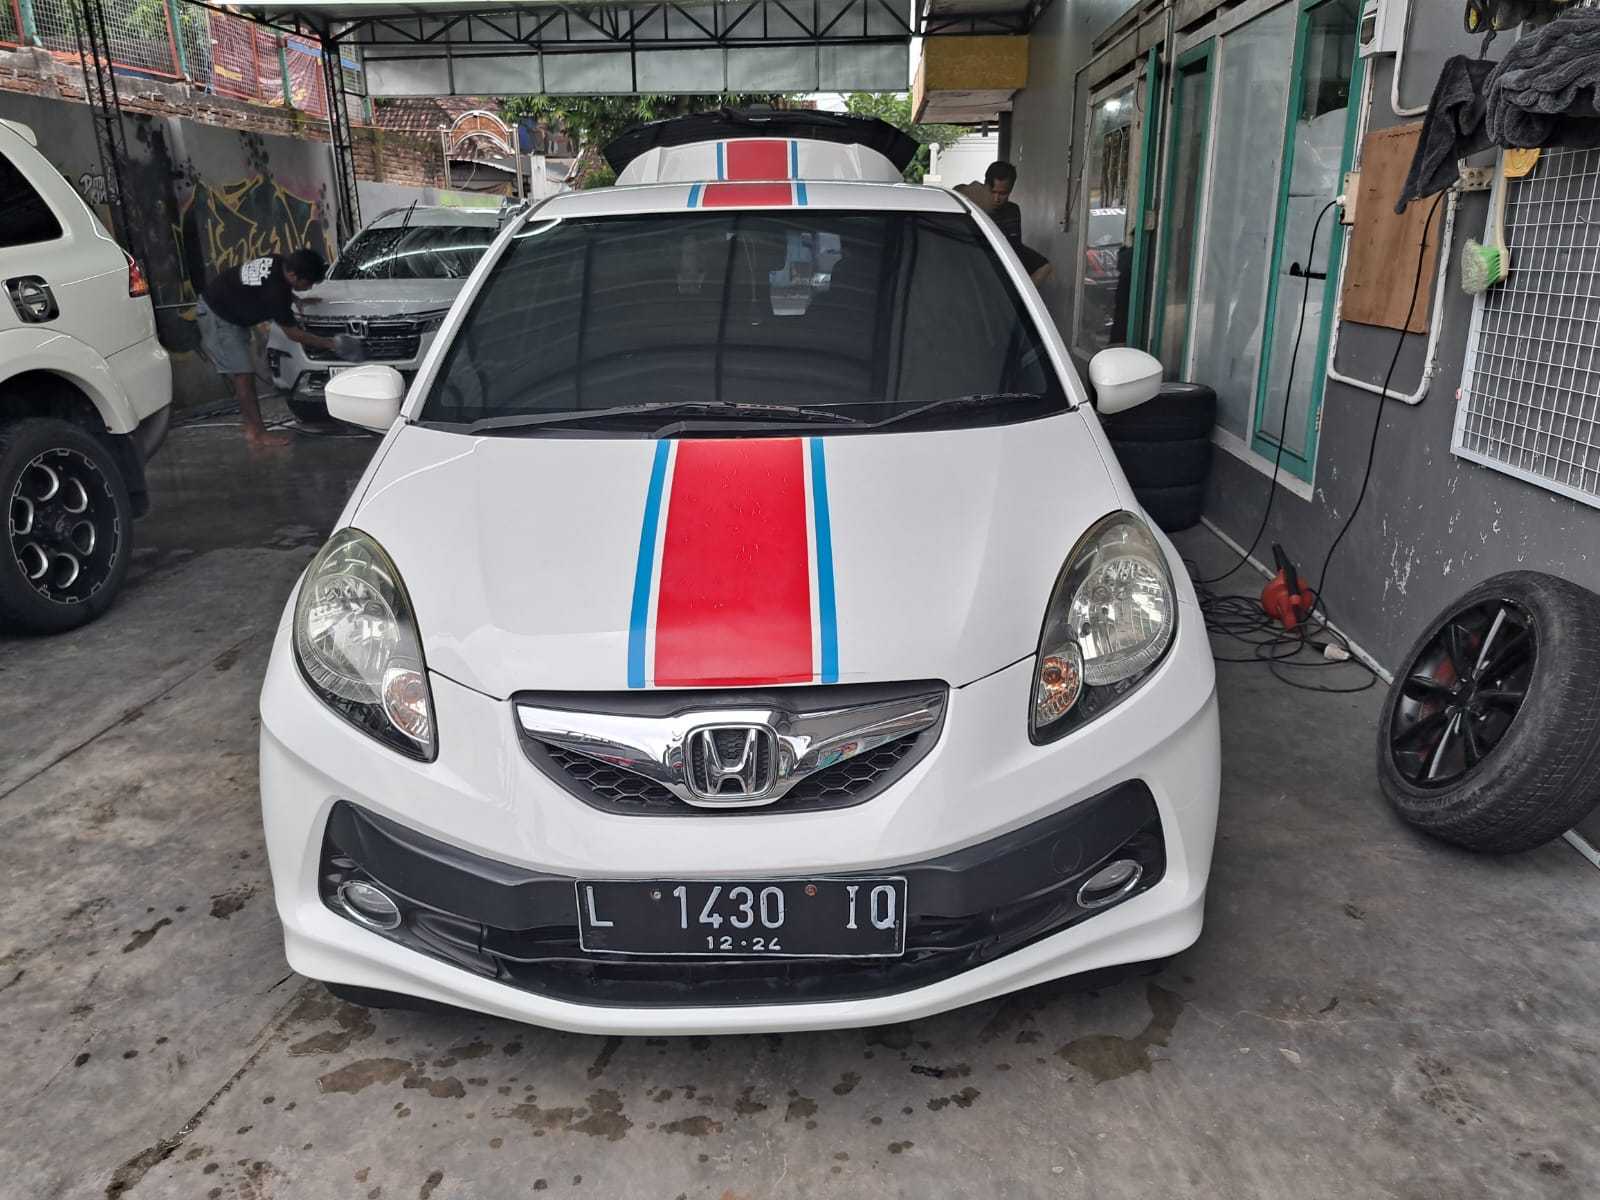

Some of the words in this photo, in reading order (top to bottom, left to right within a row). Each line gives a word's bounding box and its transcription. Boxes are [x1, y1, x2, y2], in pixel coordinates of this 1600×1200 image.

[586, 885, 614, 927] L
[673, 885, 785, 929] 1430
[846, 884, 896, 930] IQ
